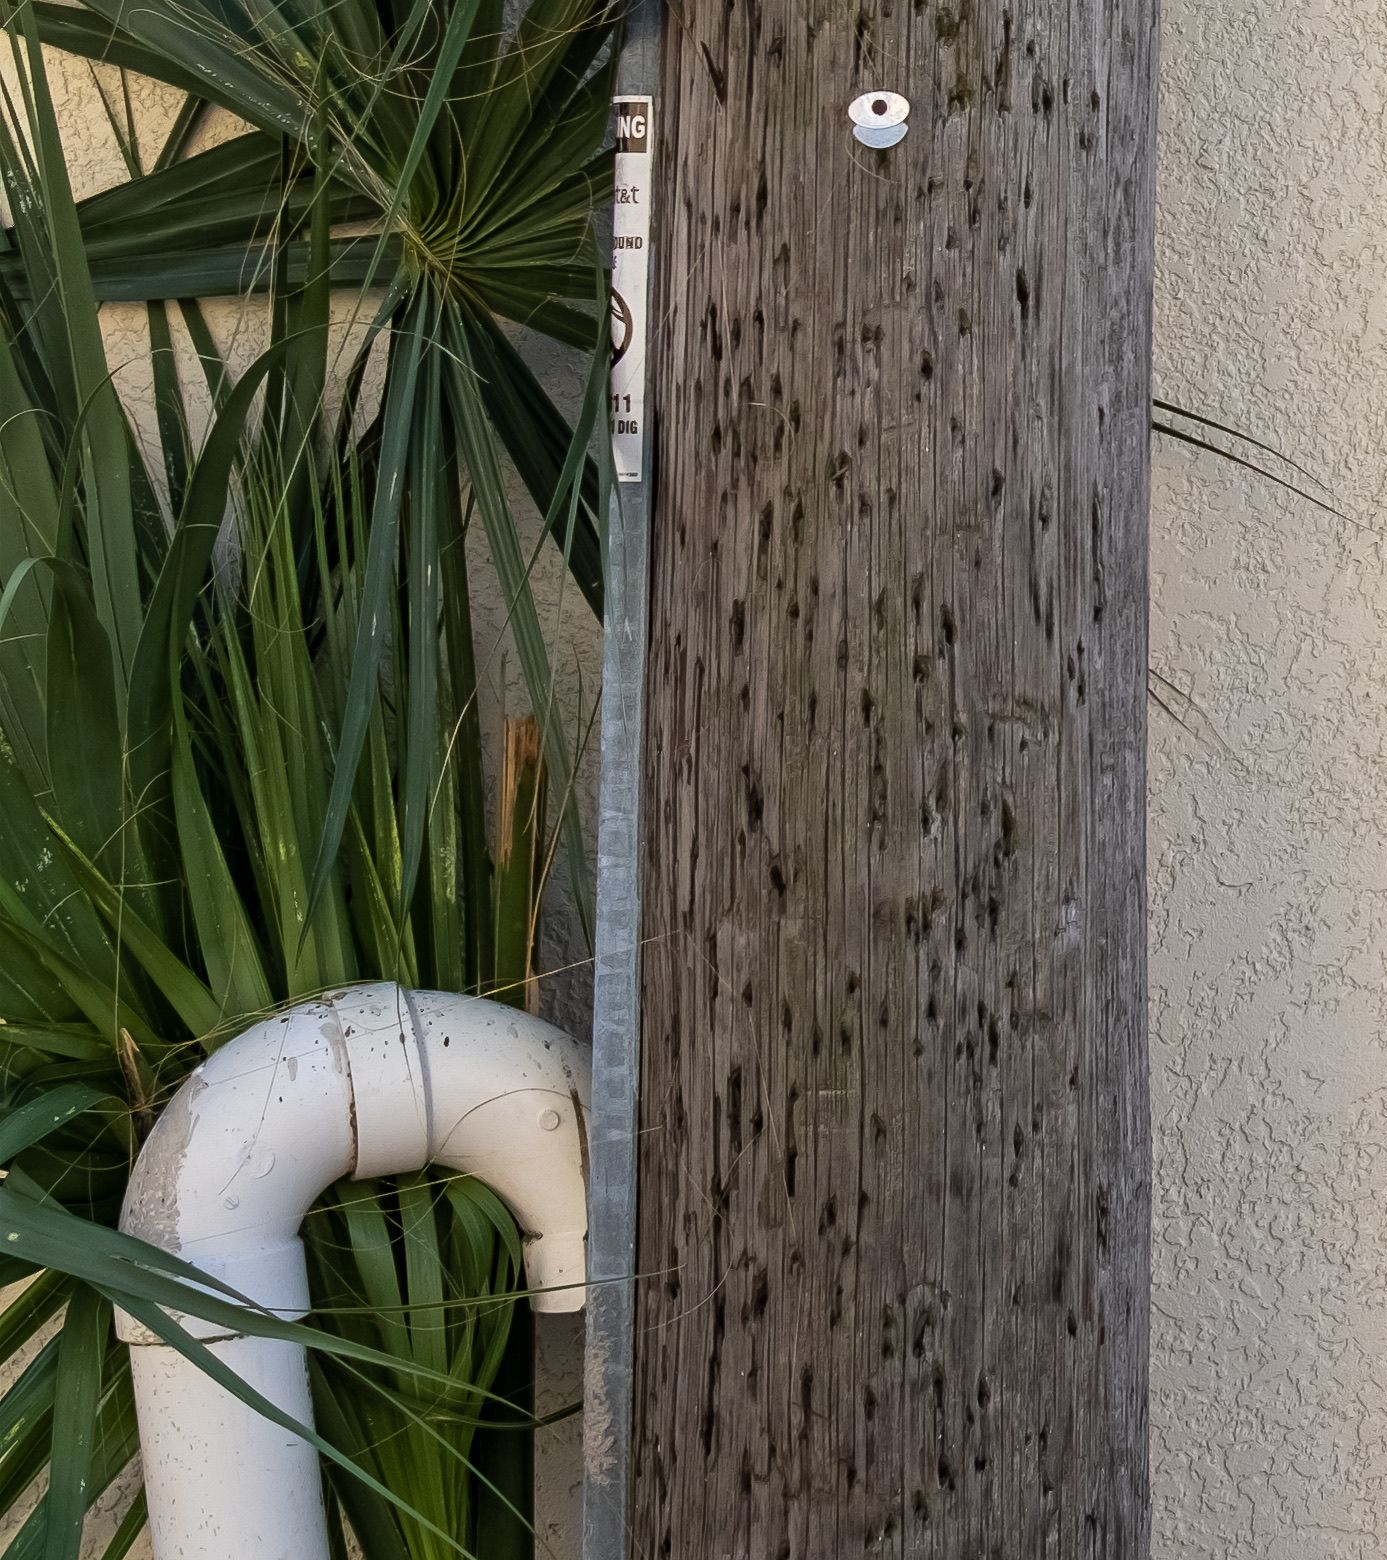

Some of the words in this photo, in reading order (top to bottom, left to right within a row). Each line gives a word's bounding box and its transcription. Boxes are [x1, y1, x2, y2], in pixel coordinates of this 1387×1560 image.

[615, 185, 640, 204] t&t
[610, 393, 631, 413] 11
[618, 420, 638, 434] DIG
